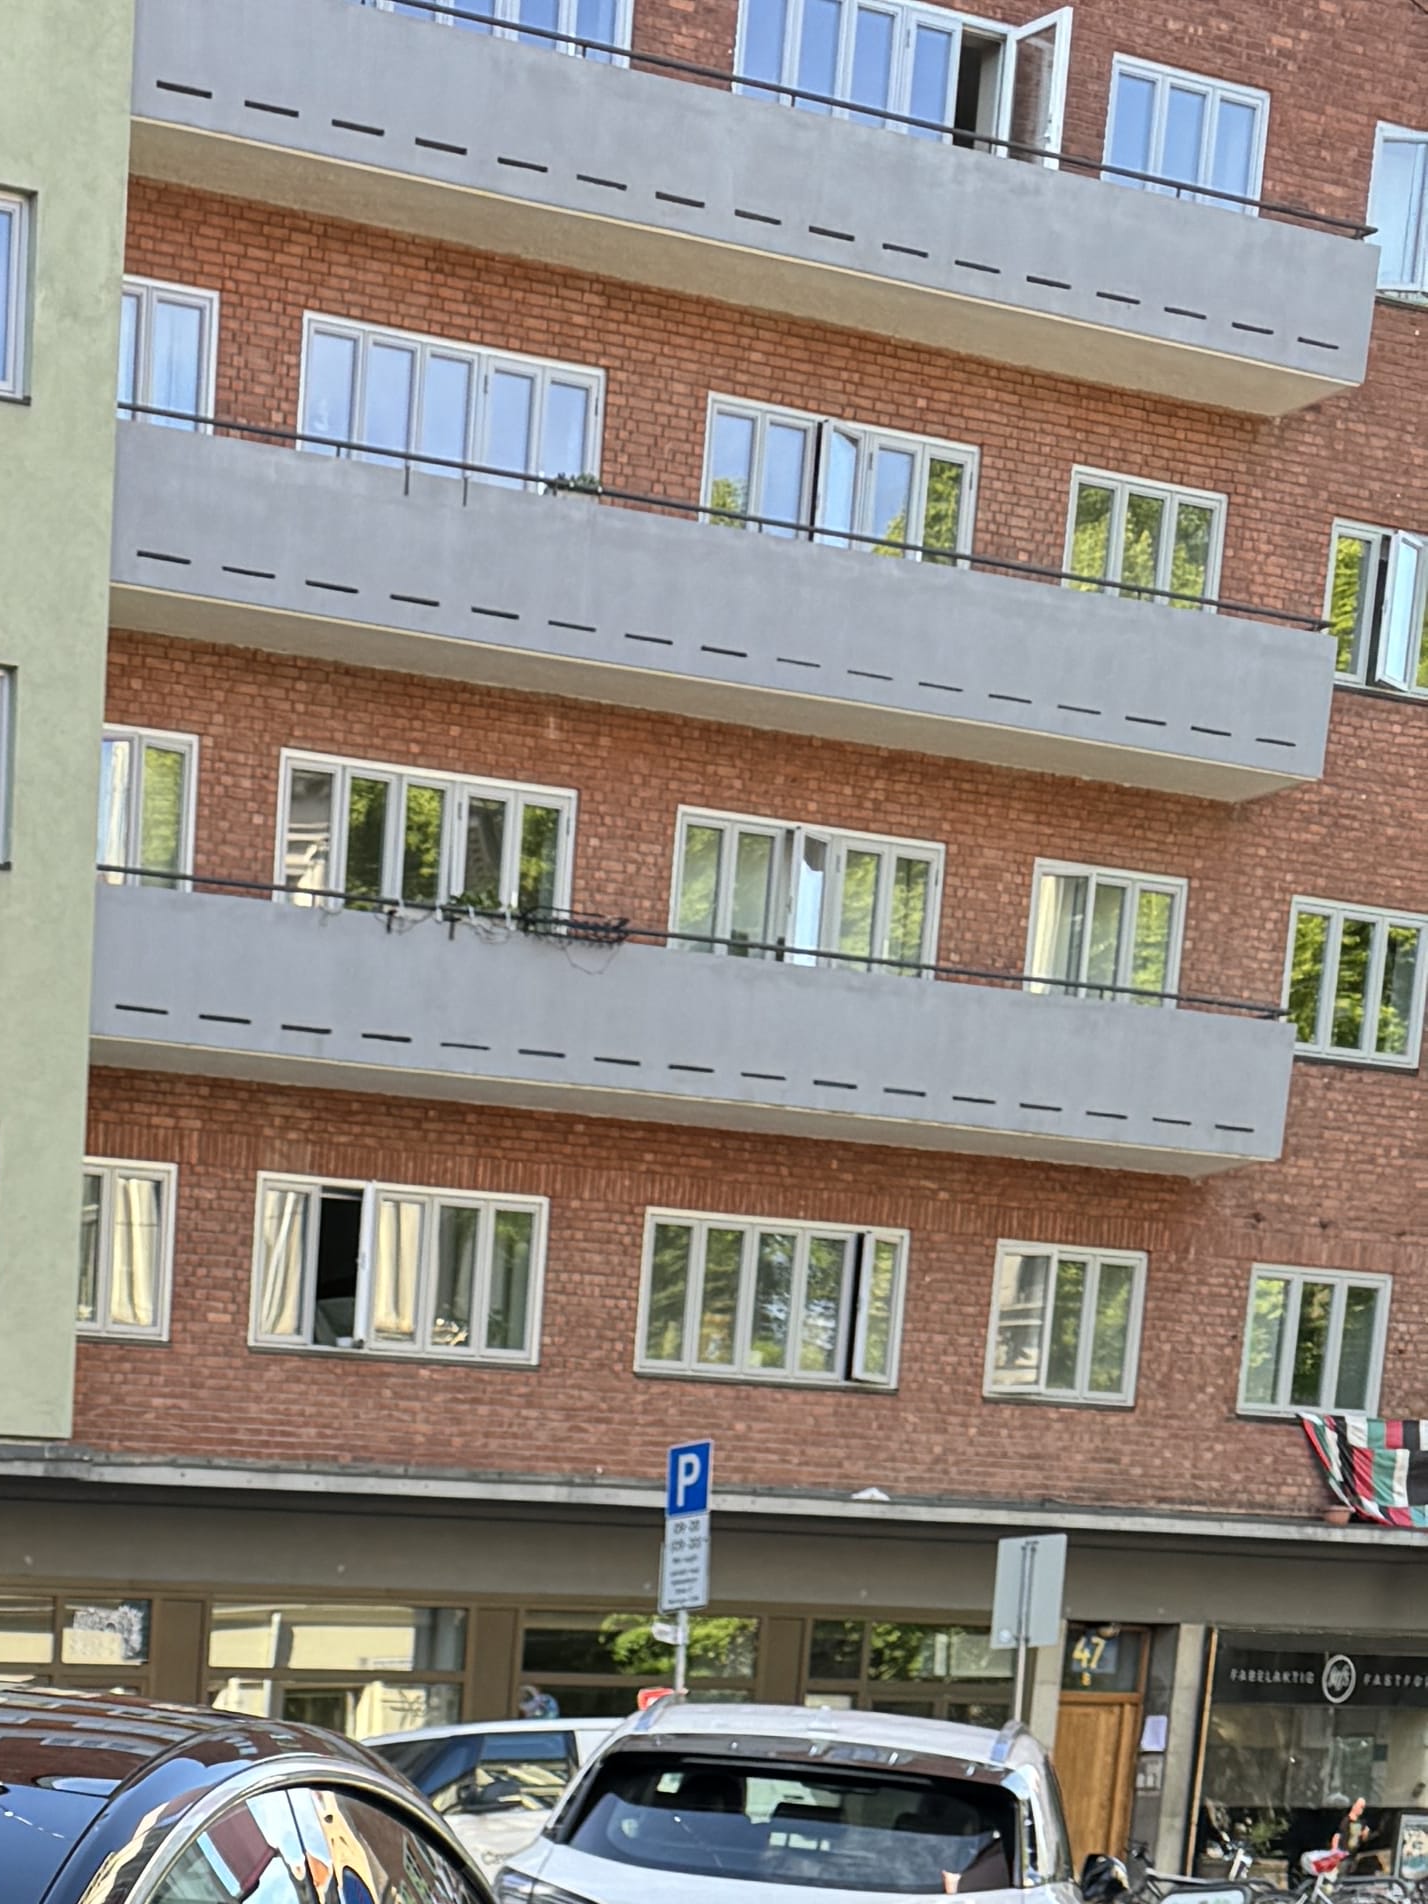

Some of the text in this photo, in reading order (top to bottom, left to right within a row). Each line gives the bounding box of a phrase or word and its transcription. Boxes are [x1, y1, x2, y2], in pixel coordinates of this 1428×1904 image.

[676, 1452, 702, 1508] P
[1071, 1636, 1106, 1669] 47
[1230, 1667, 1315, 1686] FABELAKTIG
